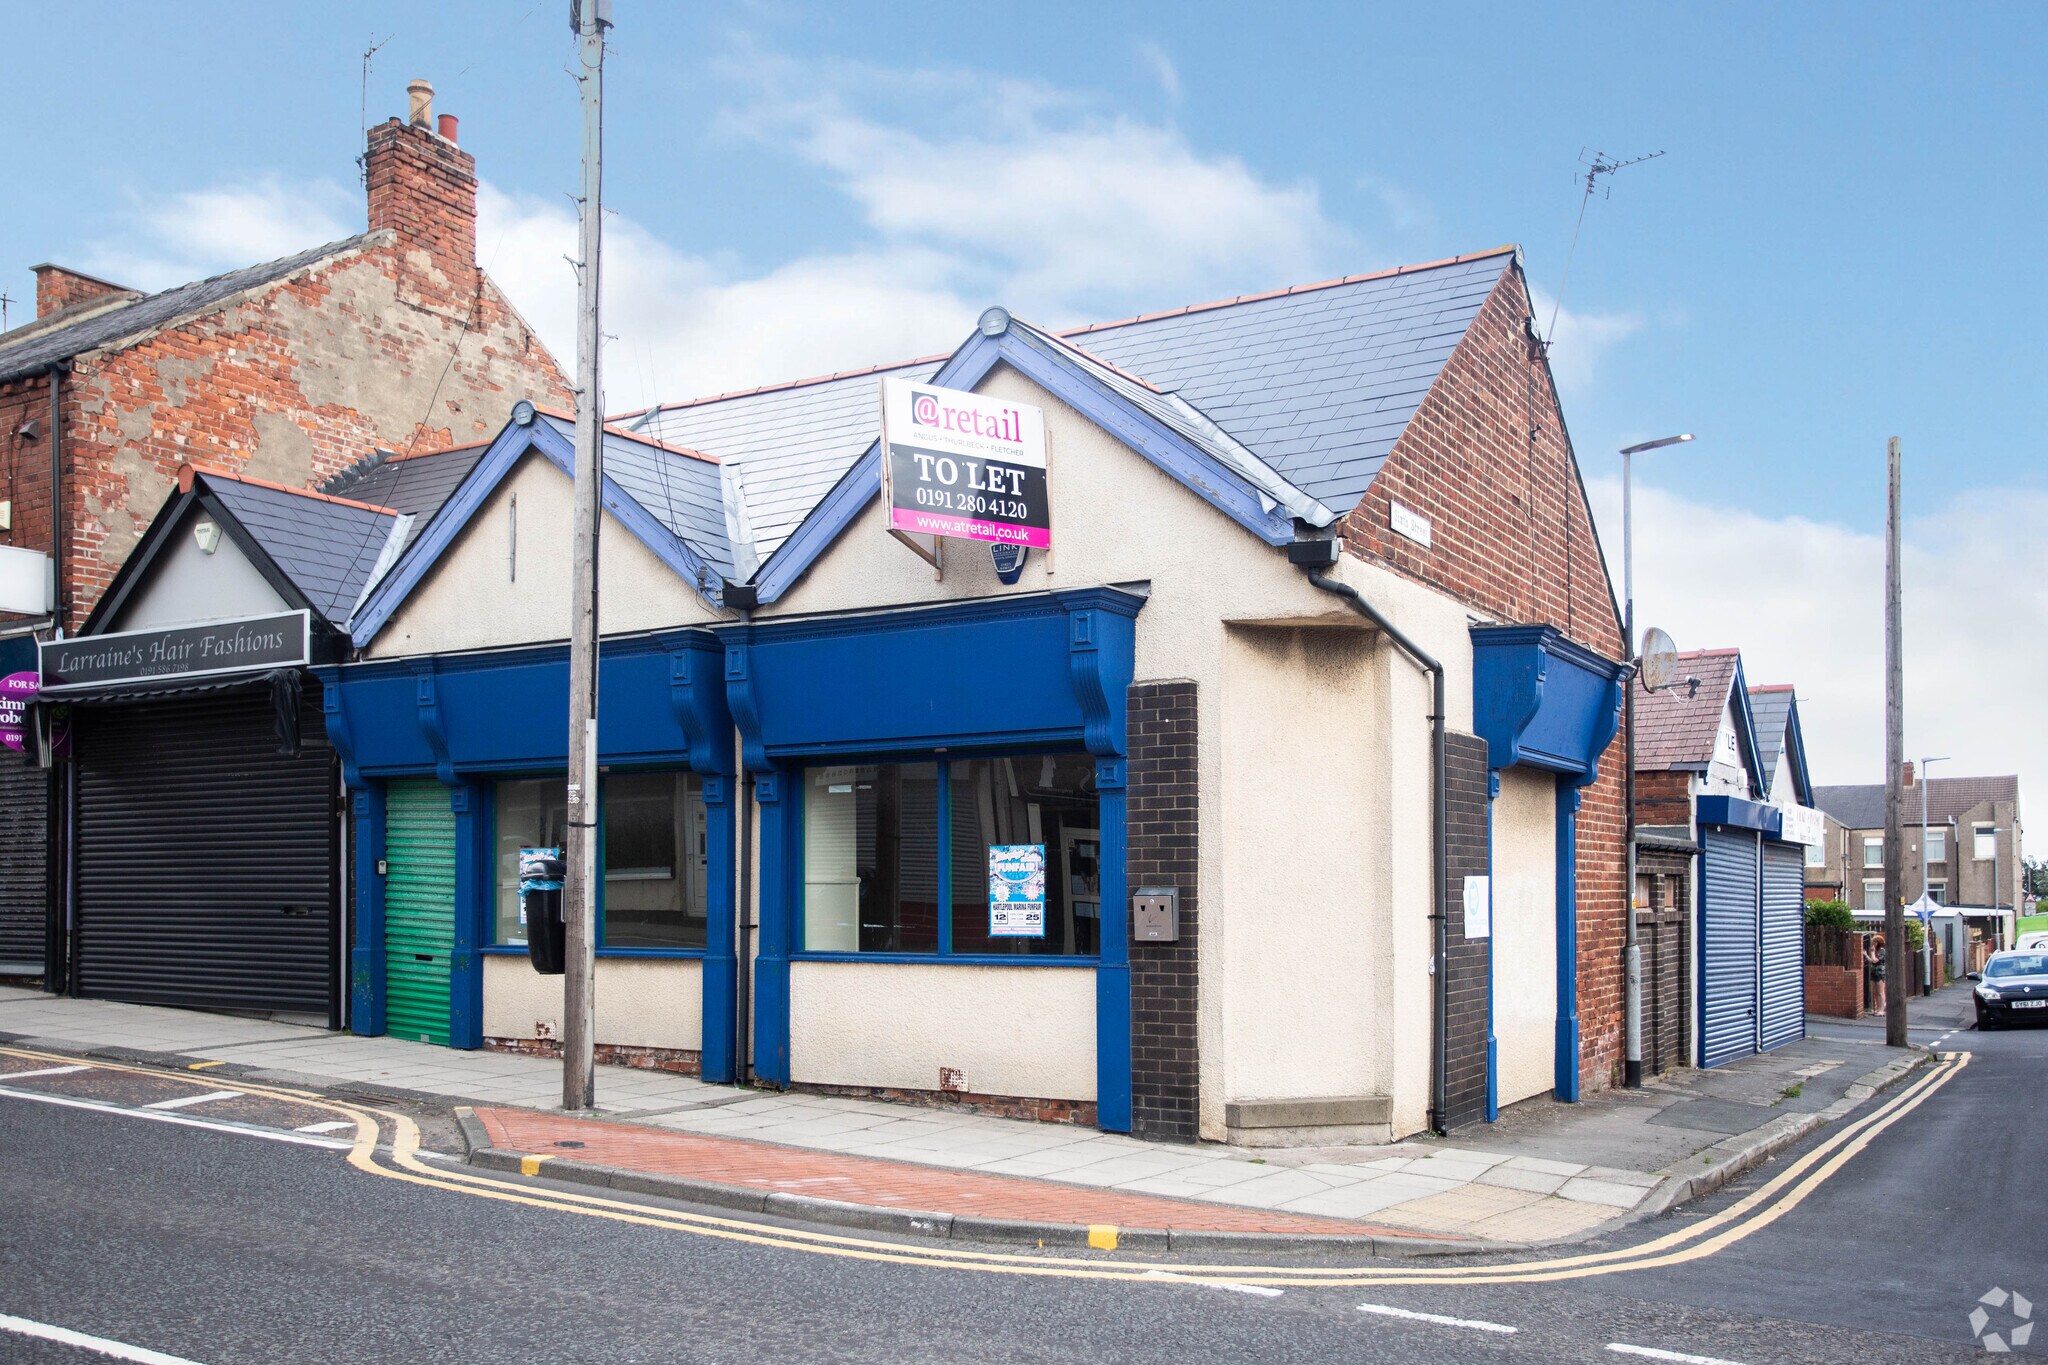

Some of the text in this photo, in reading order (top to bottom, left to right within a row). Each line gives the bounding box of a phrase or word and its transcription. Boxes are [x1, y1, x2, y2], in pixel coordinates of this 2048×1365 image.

[912, 391, 1023, 443] @retail
[913, 431, 1024, 457] ANGUS THURLBECK FLETCHER
[914, 454, 1025, 496] TO LET
[916, 487, 1027, 519] 0191 280 4120
[917, 517, 1029, 540] www.atretail.co.uk
[57, 625, 284, 673] Larraine's Hair Fashions
[139, 662, 190, 677] 0191 586 7198
[8, 679, 40, 690] FOR SA
[5, 733, 23, 742] 0191
[994, 913, 1007, 921] 12
[1025, 913, 1040, 921] 25
